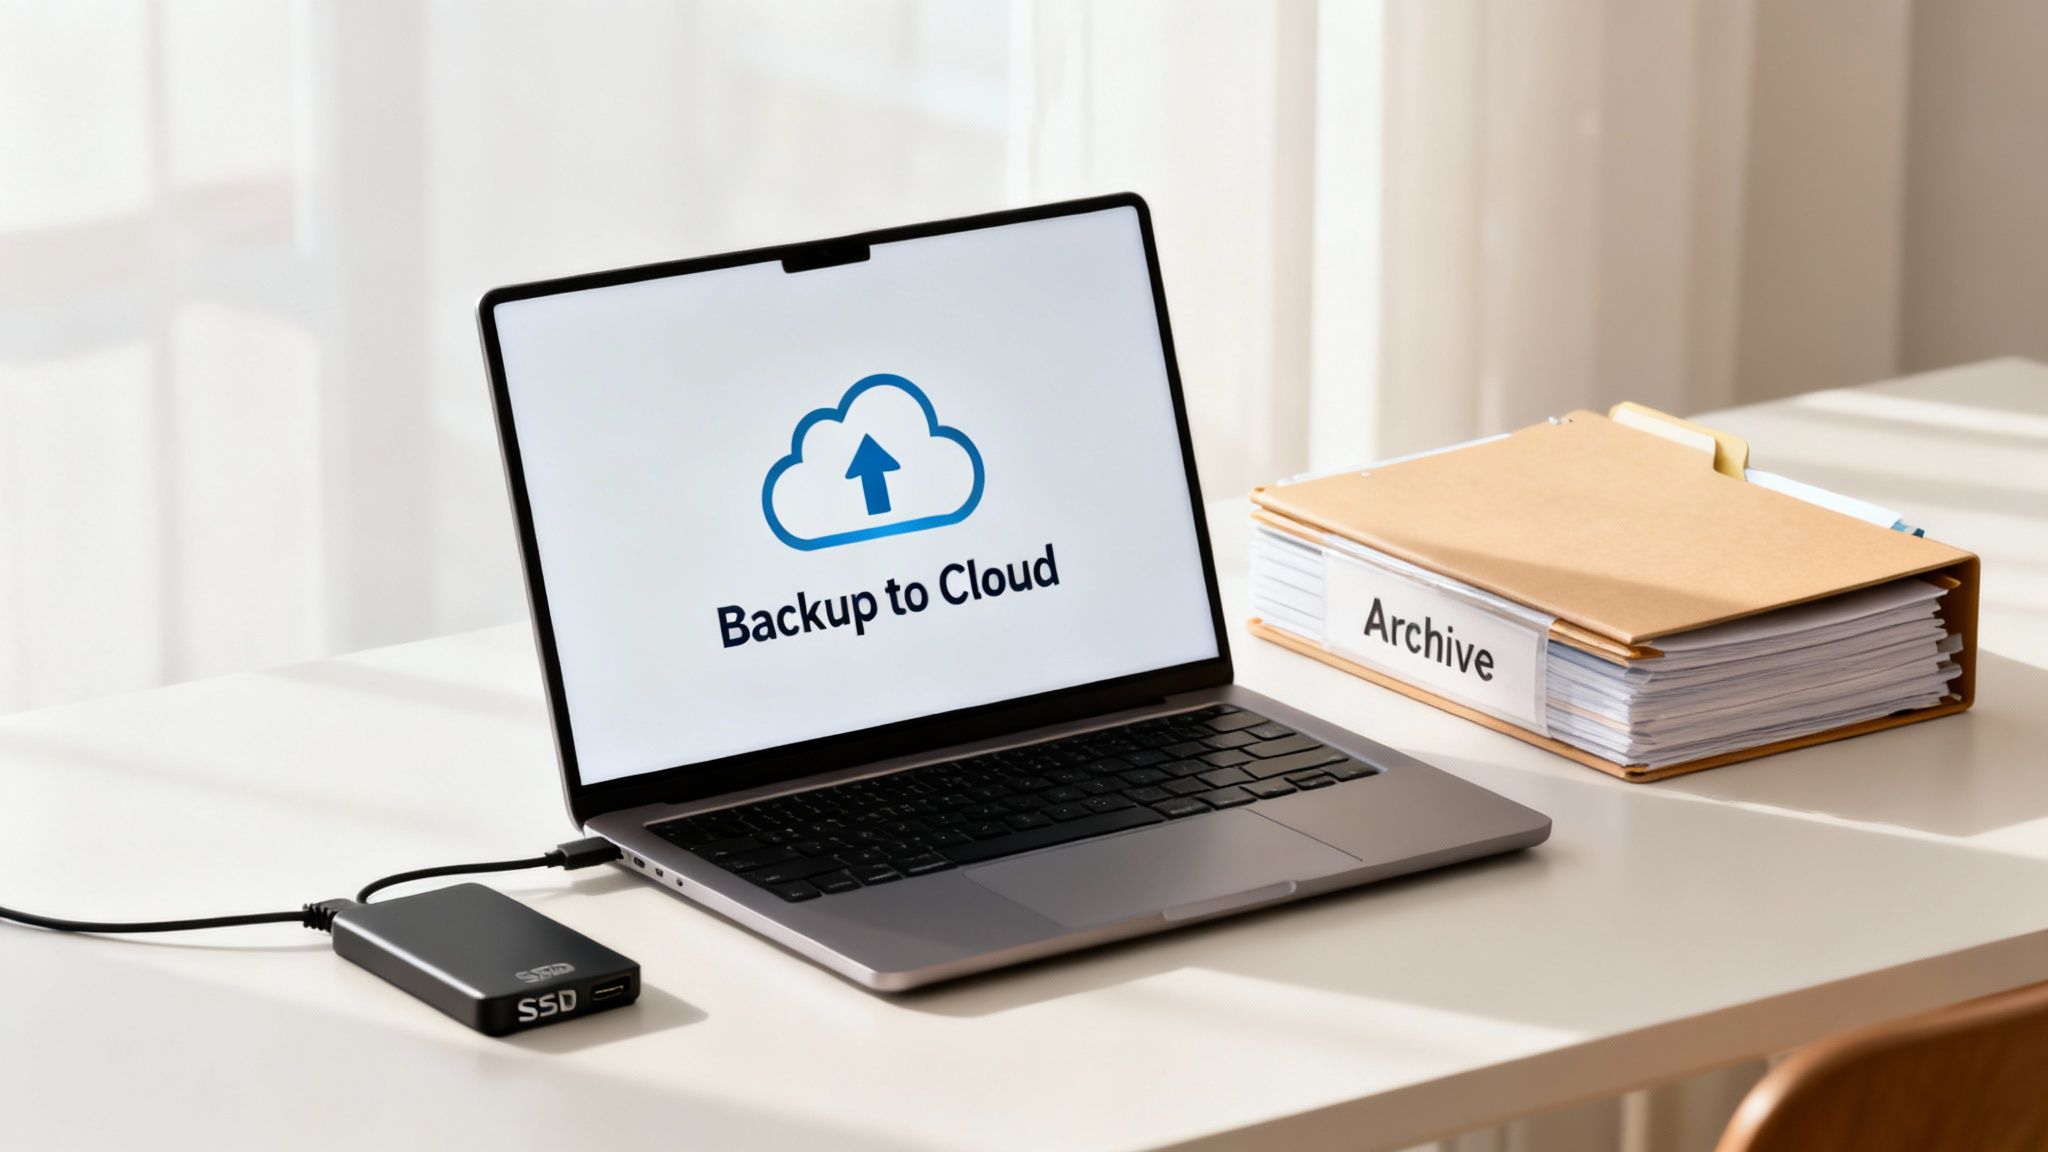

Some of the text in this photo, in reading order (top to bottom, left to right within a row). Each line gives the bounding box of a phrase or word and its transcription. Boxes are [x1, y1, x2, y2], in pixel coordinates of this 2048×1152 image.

[717, 543, 1060, 648] Backup to Cloud
[1364, 597, 1494, 681] Archive
[517, 989, 577, 1022] SSD
